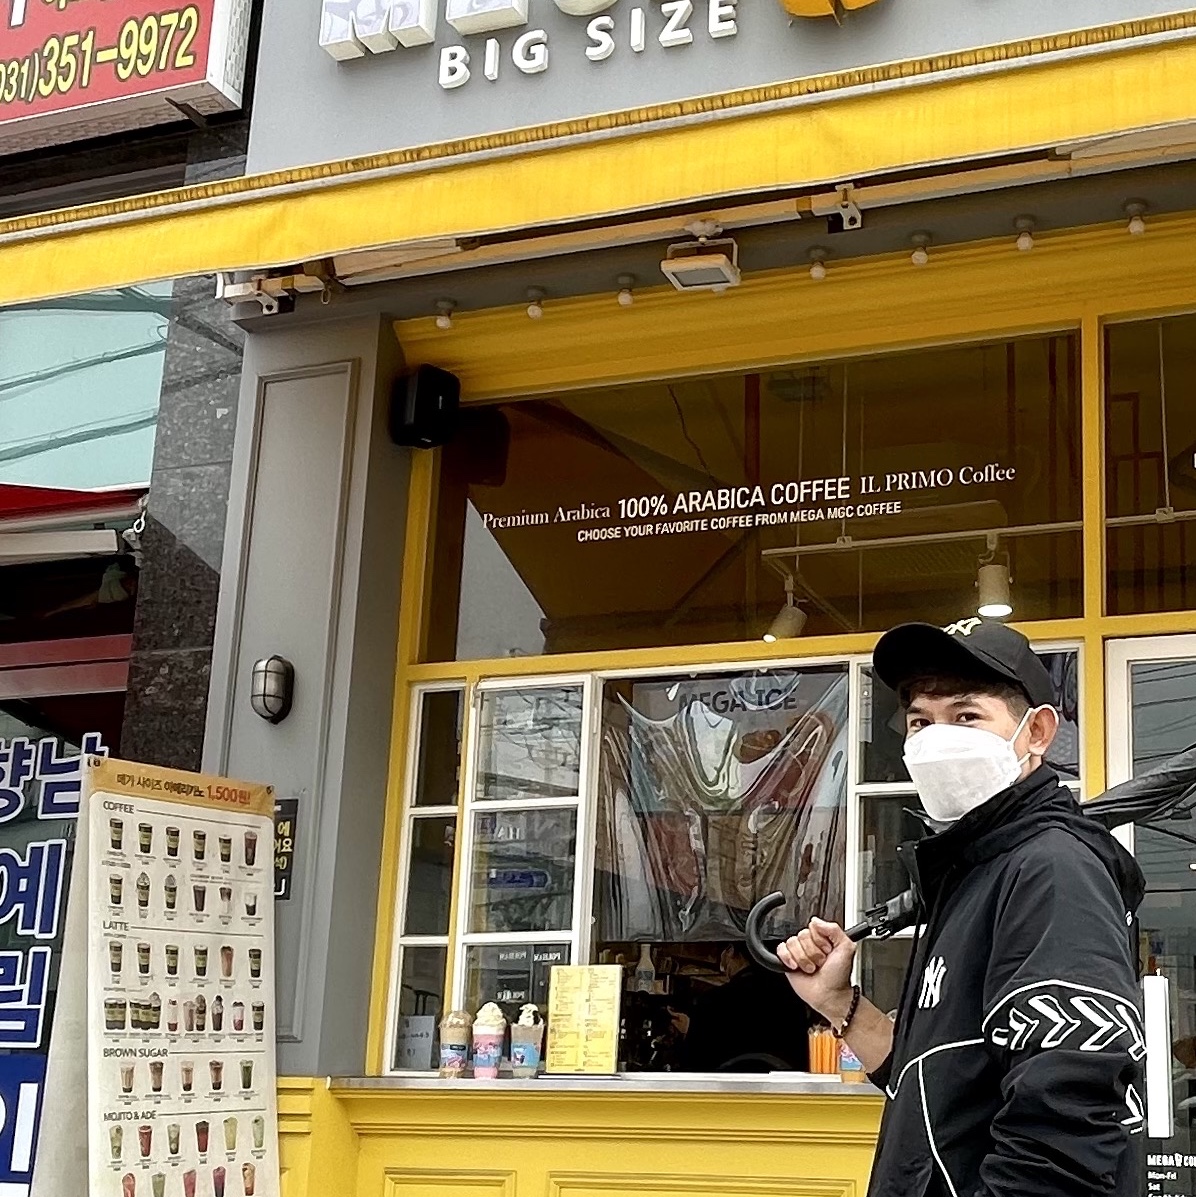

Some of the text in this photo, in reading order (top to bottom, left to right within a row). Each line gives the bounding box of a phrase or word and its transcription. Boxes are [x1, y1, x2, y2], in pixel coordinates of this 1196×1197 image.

[439, 29, 549, 89] BIG
[585, 0, 738, 62] SIZE
[482, 509, 550, 529] Premium
[553, 502, 612, 524] Arabica
[617, 493, 669, 519] 100%
[672, 485, 766, 515] ARABICA
[770, 476, 851, 505] COFFEE
[885, 468, 954, 492] PRIMO
[958, 462, 1016, 485] Coffee
[577, 500, 902, 543] CHOOSE YOUR FAVORITE COFFEE FROM MEGA MGC COFFEE
[103, 801, 135, 814] COFFEE
[103, 920, 130, 931] LATTE
[103, 1048, 169, 1058] BROWN SUGAR
[140, 1110, 157, 1120] ADE
[1146, 1154, 1175, 1167] MEGA
